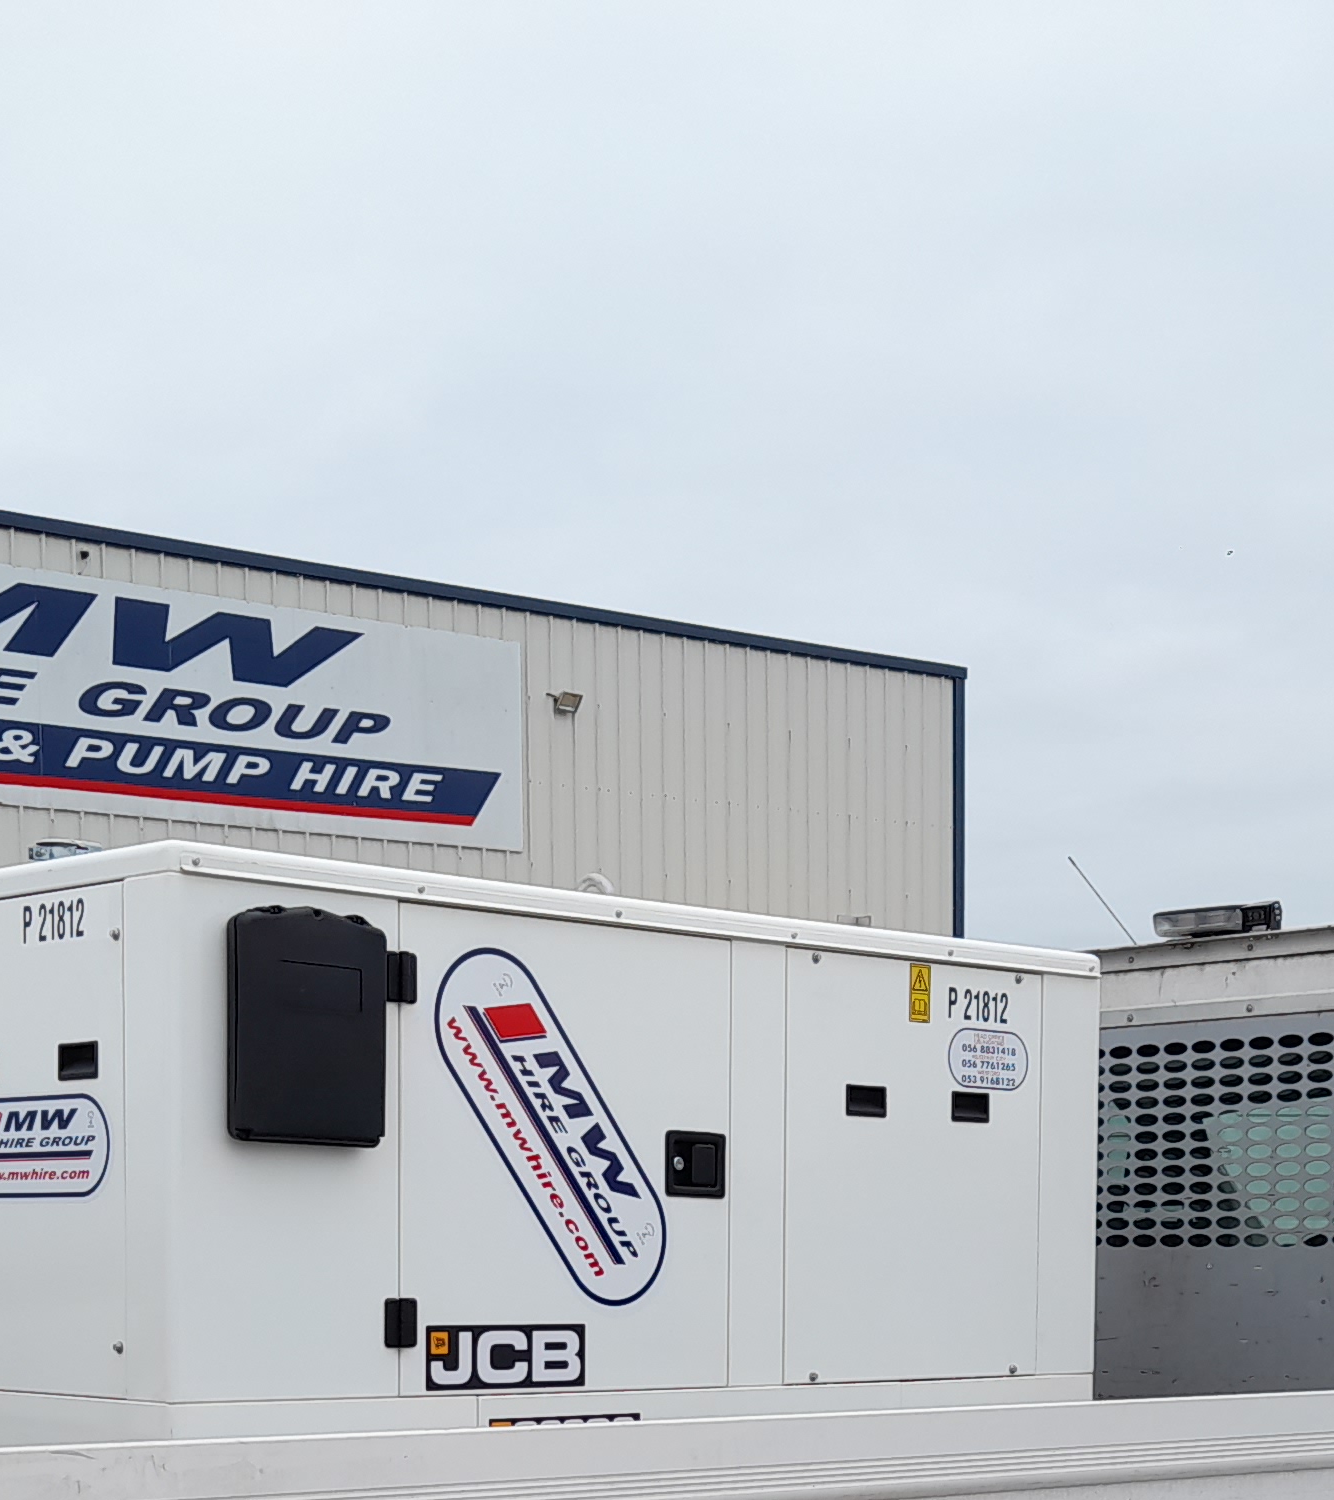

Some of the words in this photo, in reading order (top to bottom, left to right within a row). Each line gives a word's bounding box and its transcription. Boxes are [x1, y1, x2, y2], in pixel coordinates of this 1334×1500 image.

[77, 681, 392, 747] GROUP
[65, 735, 272, 787] PUMP
[289, 761, 446, 804] HIRE
[23, 905, 33, 944] P
[38, 898, 85, 942] 21812
[948, 986, 958, 1018] P
[964, 988, 1009, 1024] 21812
[962, 1043, 977, 1053] 056
[962, 1059, 977, 1069] 056
[980, 1061, 1016, 1071] 7761265
[962, 1074, 977, 1084] 053
[3, 1107, 79, 1133] MW
[39, 1134, 97, 1147] GROUP
[533, 1051, 642, 1199] MW
[446, 1016, 605, 1277] www.mwhire.com
[511, 1054, 568, 1135] HIRE
[566, 1146, 639, 1259] GROUP
[429, 1330, 582, 1386] JCB
